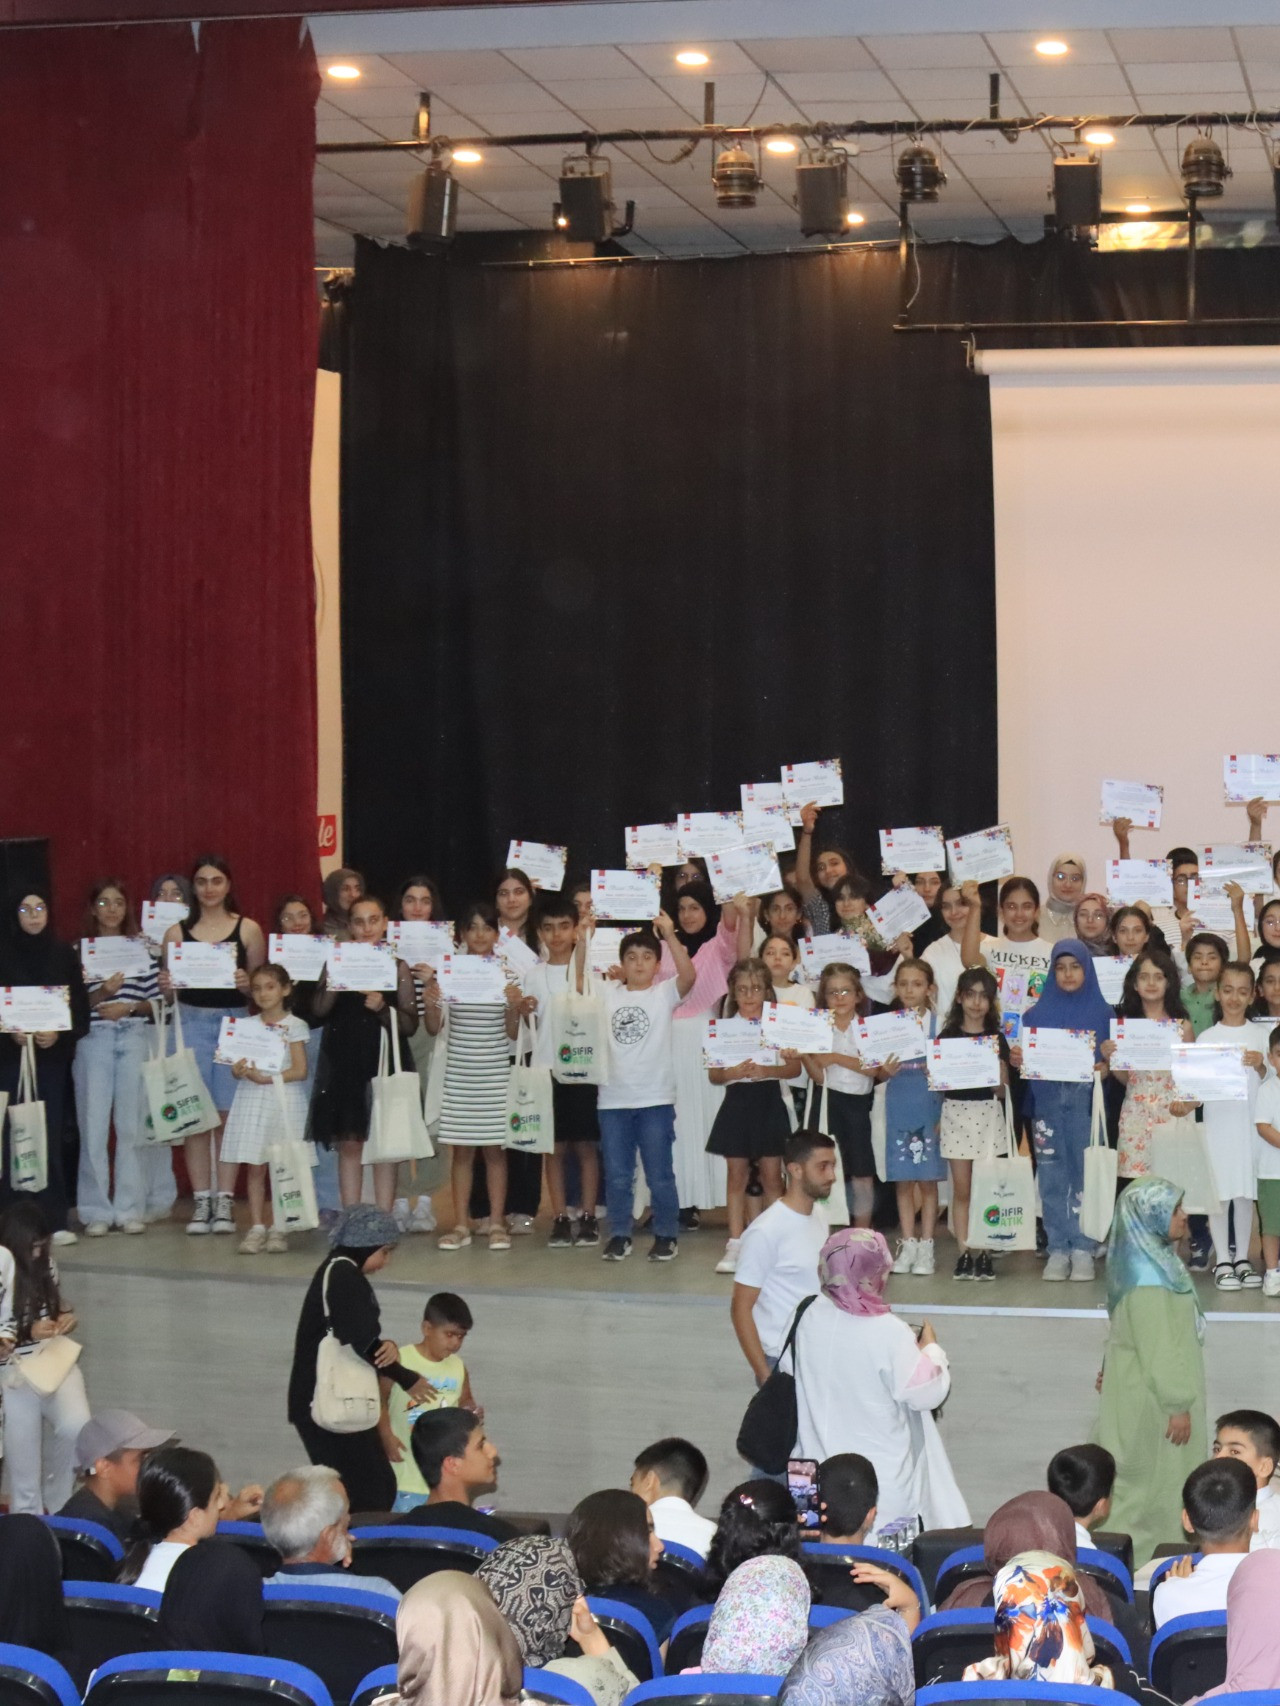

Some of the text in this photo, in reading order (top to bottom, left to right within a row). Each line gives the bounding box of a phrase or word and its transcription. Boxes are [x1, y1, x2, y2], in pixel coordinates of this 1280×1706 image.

[991, 948, 1051, 968] MICKEY
[572, 1046, 593, 1055] SIFIR
[1000, 1216, 1024, 1227] ATIK
